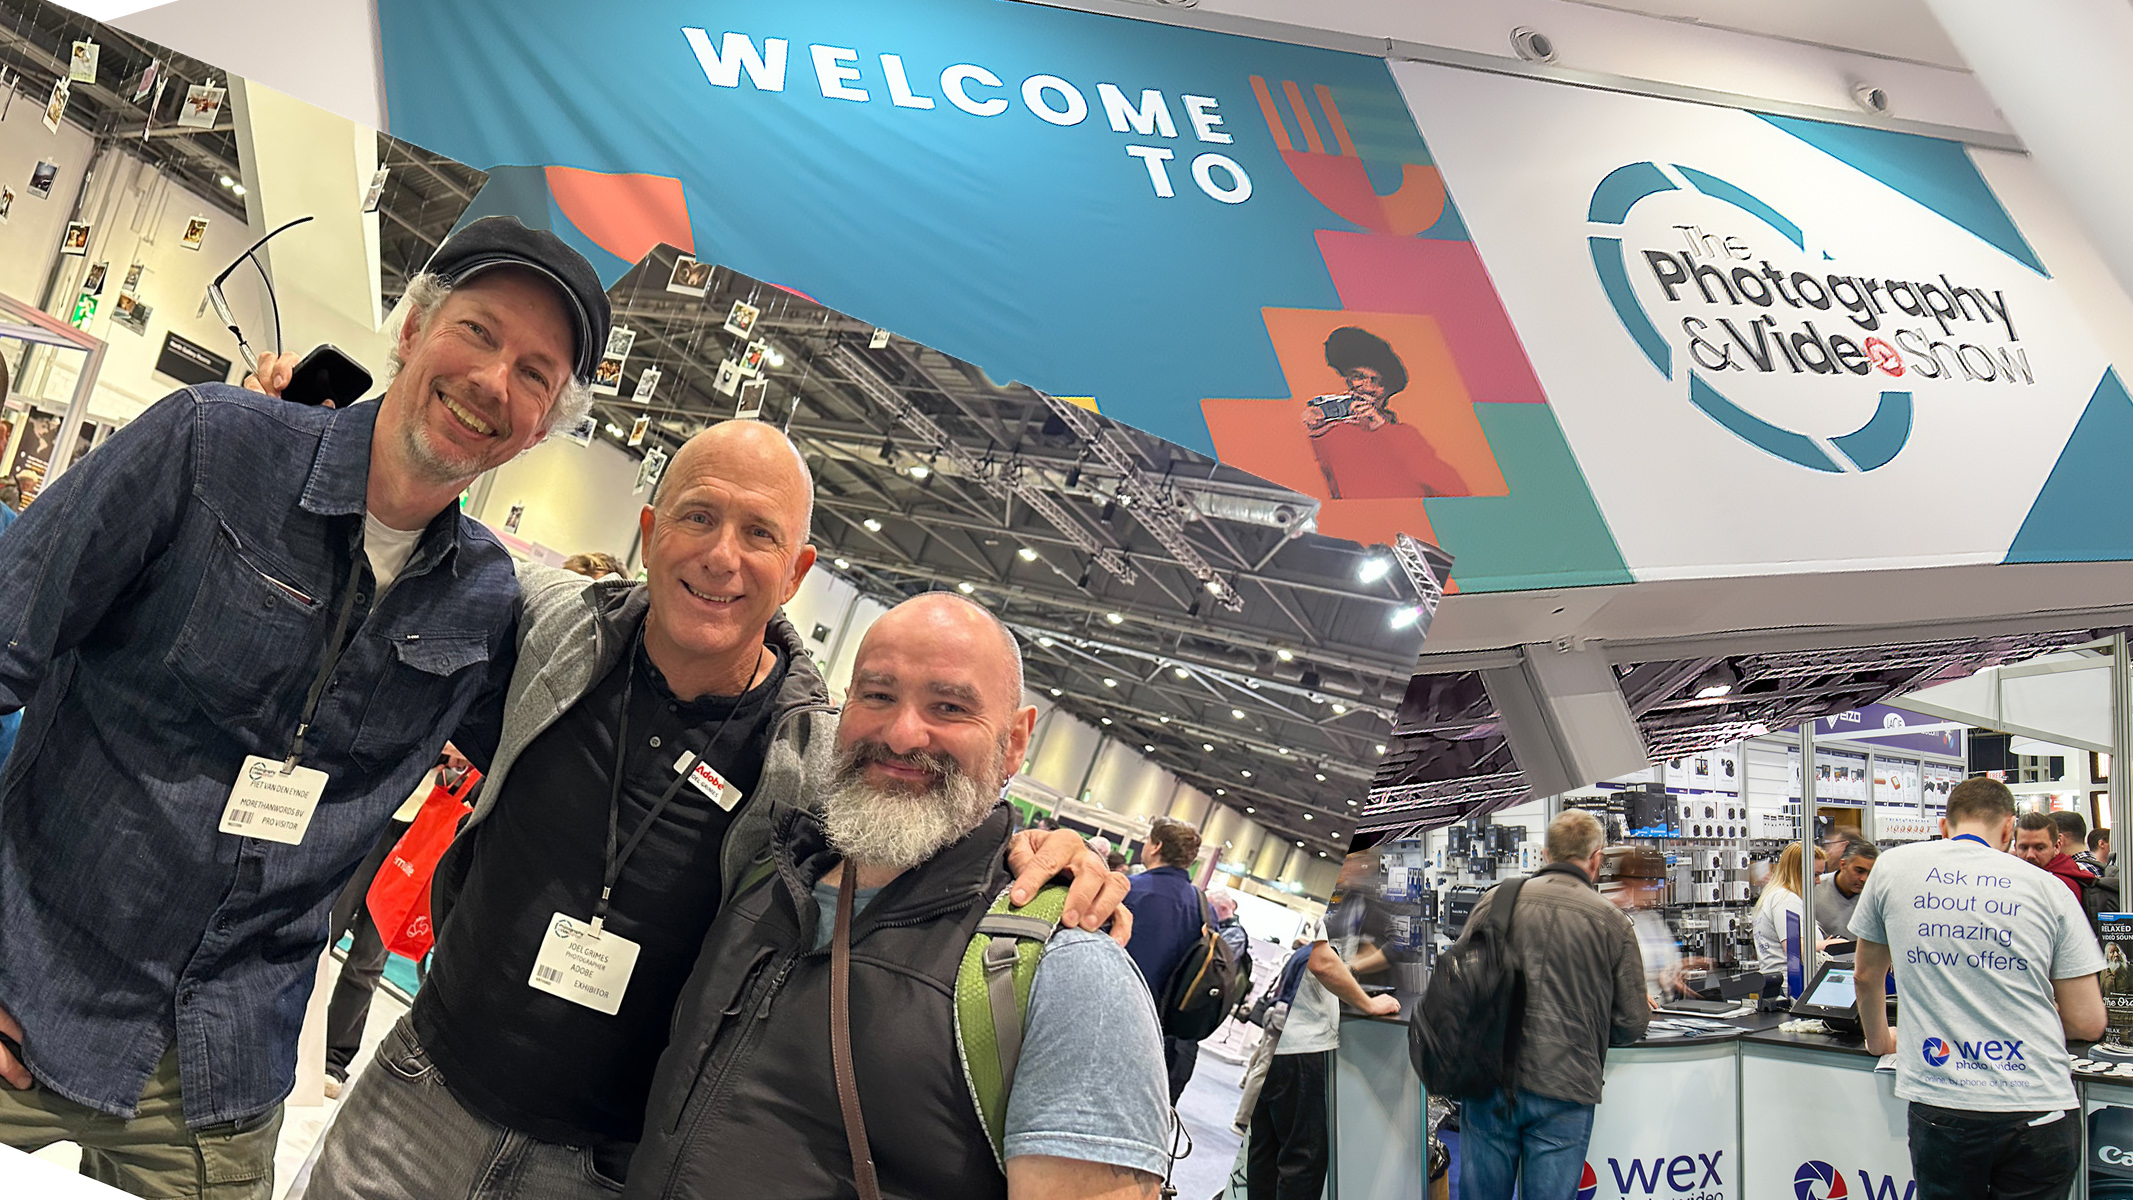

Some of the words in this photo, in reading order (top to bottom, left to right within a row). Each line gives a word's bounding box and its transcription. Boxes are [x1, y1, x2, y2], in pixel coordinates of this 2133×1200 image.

[681, 26, 1234, 145] WELCOME
[1125, 144, 1253, 205] TO
[1672, 225, 1752, 260] The
[1641, 250, 2021, 342] Photography
[1895, 328, 2034, 386] Show
[1840, 711, 1861, 723] EIZO
[695, 765, 724, 790] Adobe
[264, 782, 276, 791] VAN
[276, 784, 289, 793] DEN
[289, 787, 310, 799] EYNDE
[240, 798, 295, 816] MORETHANWORDS
[294, 809, 305, 818] BV
[261, 816, 275, 826] PRO
[275, 820, 298, 831] VISITOR
[1925, 867, 1968, 886] Ask
[1976, 874, 2012, 889] me
[1913, 891, 1977, 912] about
[1984, 899, 2022, 917] our
[1918, 922, 2012, 947] amazing
[565, 951, 606, 971] PHOTOGRAPHER
[568, 942, 583, 954] JOEL
[584, 948, 609, 963] GRIMES
[1906, 946, 1959, 966] show
[1966, 950, 2028, 971] offers
[570, 964, 594, 978] ADOBE
[574, 979, 610, 999] EXHIBITOR
[1953, 1040, 2025, 1061] wex
[1956, 1060, 1988, 1071] photo
[1994, 1061, 2026, 1071] video
[1949, 1078, 1958, 1086] by
[1960, 1078, 1987, 1087] phone
[2000, 1079, 2008, 1087] in
[2010, 1080, 2030, 1088] store
[1607, 1150, 1723, 1194] wex
